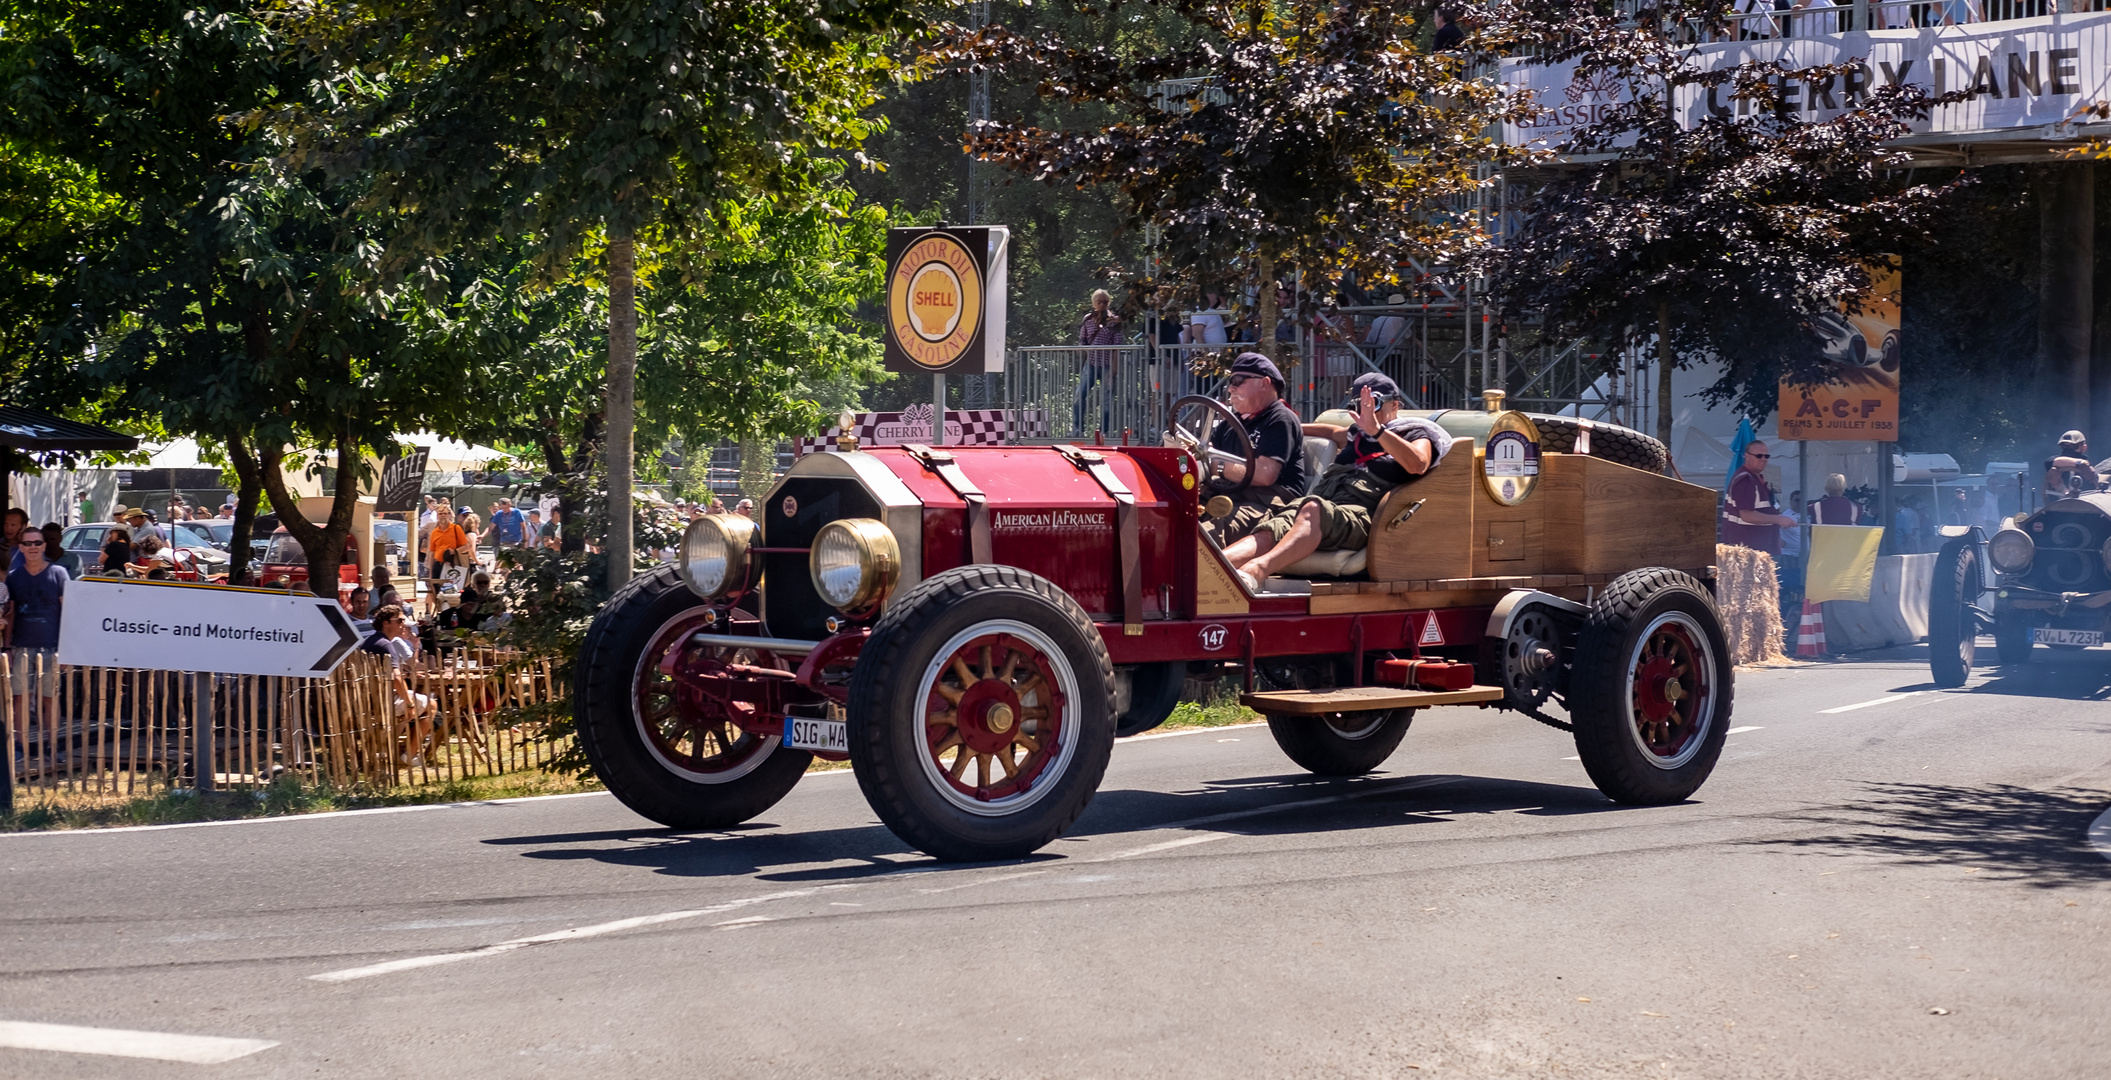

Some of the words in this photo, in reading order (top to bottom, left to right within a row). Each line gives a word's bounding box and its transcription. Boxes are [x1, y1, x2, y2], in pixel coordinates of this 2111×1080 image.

[899, 241, 947, 281] MOTOR
[950, 249, 972, 281] OIL
[916, 291, 954, 307] SHELL
[899, 324, 970, 362] GASOLINE
[877, 426, 926, 438] CHERRY
[928, 425, 960, 437] LNE
[1783, 420, 1812, 428] REIMS
[1827, 421, 1866, 429] JUILLET
[1871, 421, 1893, 430] 1938
[1503, 445, 1514, 459] 11
[383, 452, 426, 496] KAFFEE
[2048, 522, 2093, 586] 3
[1199, 548, 1219, 576] AMERICAN
[1223, 581, 1241, 604] FRANCE
[173, 623, 201, 637] and
[206, 624, 304, 643] Motorfestival
[1202, 629, 1226, 646] 147
[2034, 630, 2051, 642] RV
[793, 722, 818, 745] SIG
